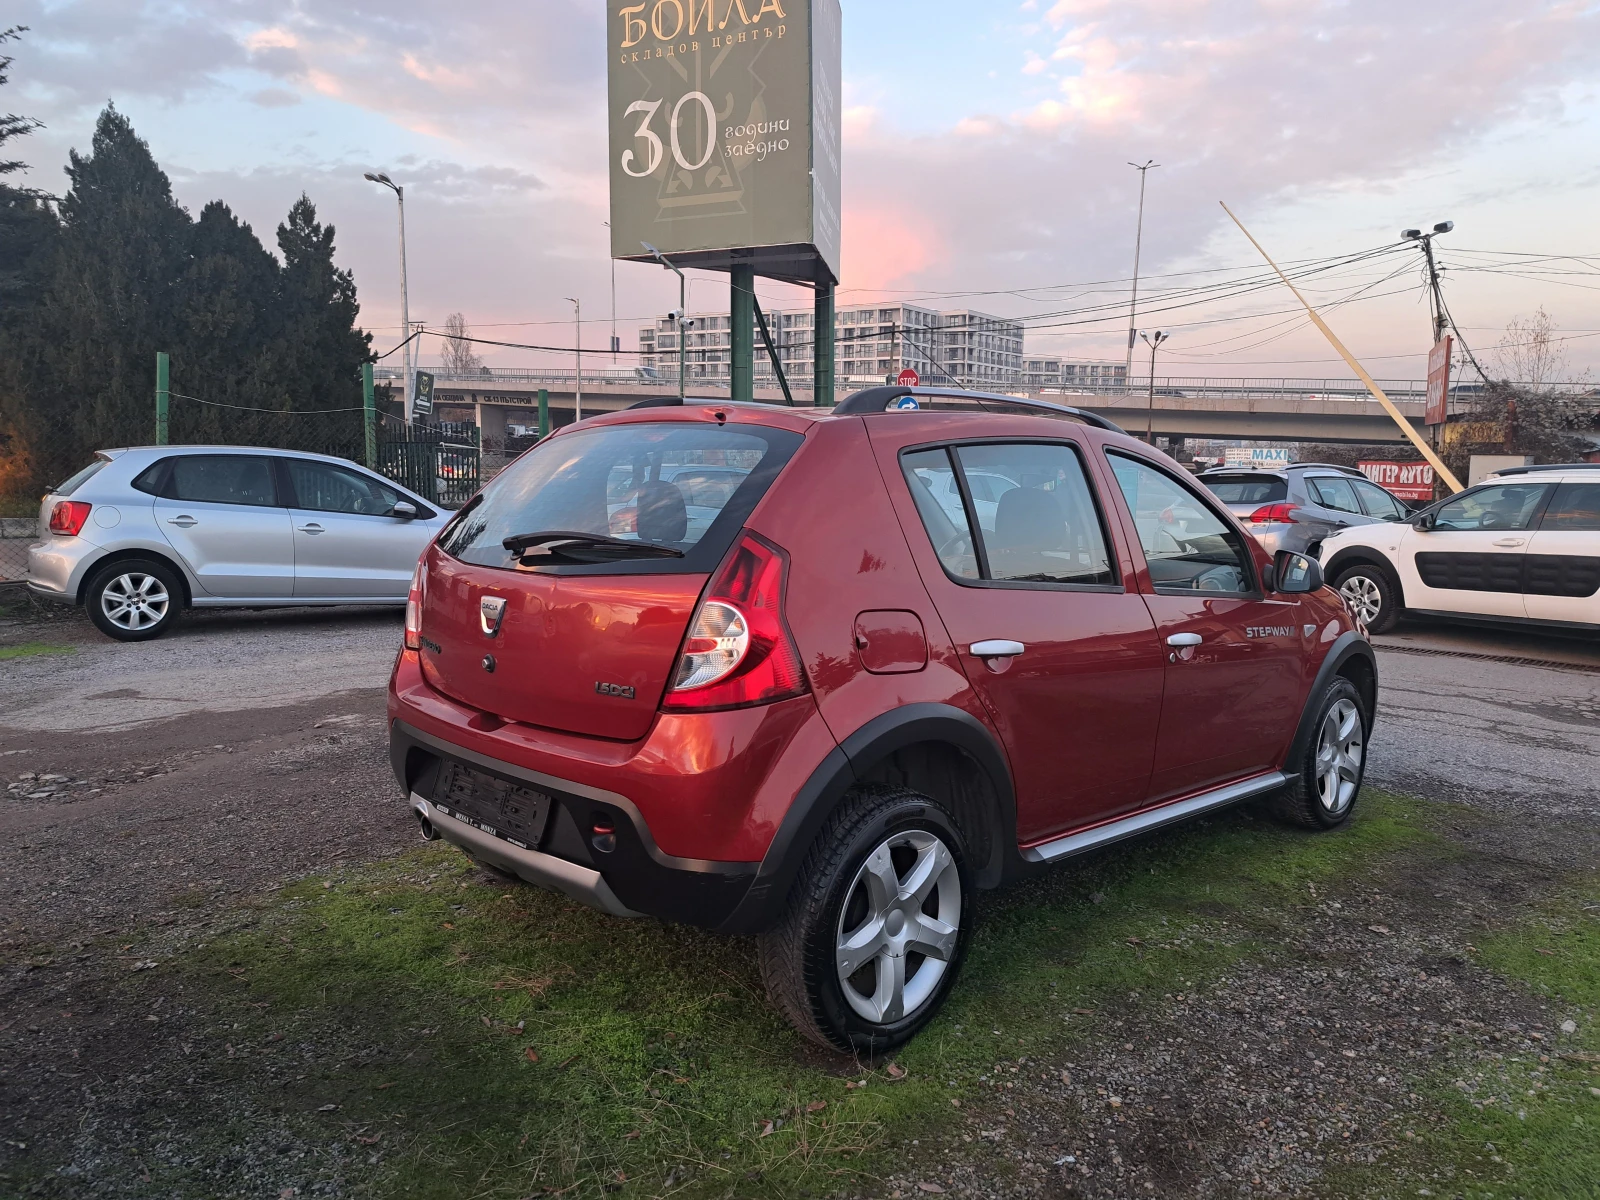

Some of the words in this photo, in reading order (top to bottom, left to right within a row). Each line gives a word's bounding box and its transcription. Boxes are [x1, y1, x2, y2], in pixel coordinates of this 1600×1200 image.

[620, 41, 700, 64] складов
[712, 24, 787, 48] център
[621, 91, 717, 177] 30
[724, 118, 790, 143] години
[724, 138, 790, 162] заедно
[899, 377, 917, 387] STOP
[1251, 449, 1288, 460] MAXI
[1400, 465, 1433, 484] АУТО
[482, 602, 499, 612] DACIA
[1246, 625, 1290, 638] STEPWAY
